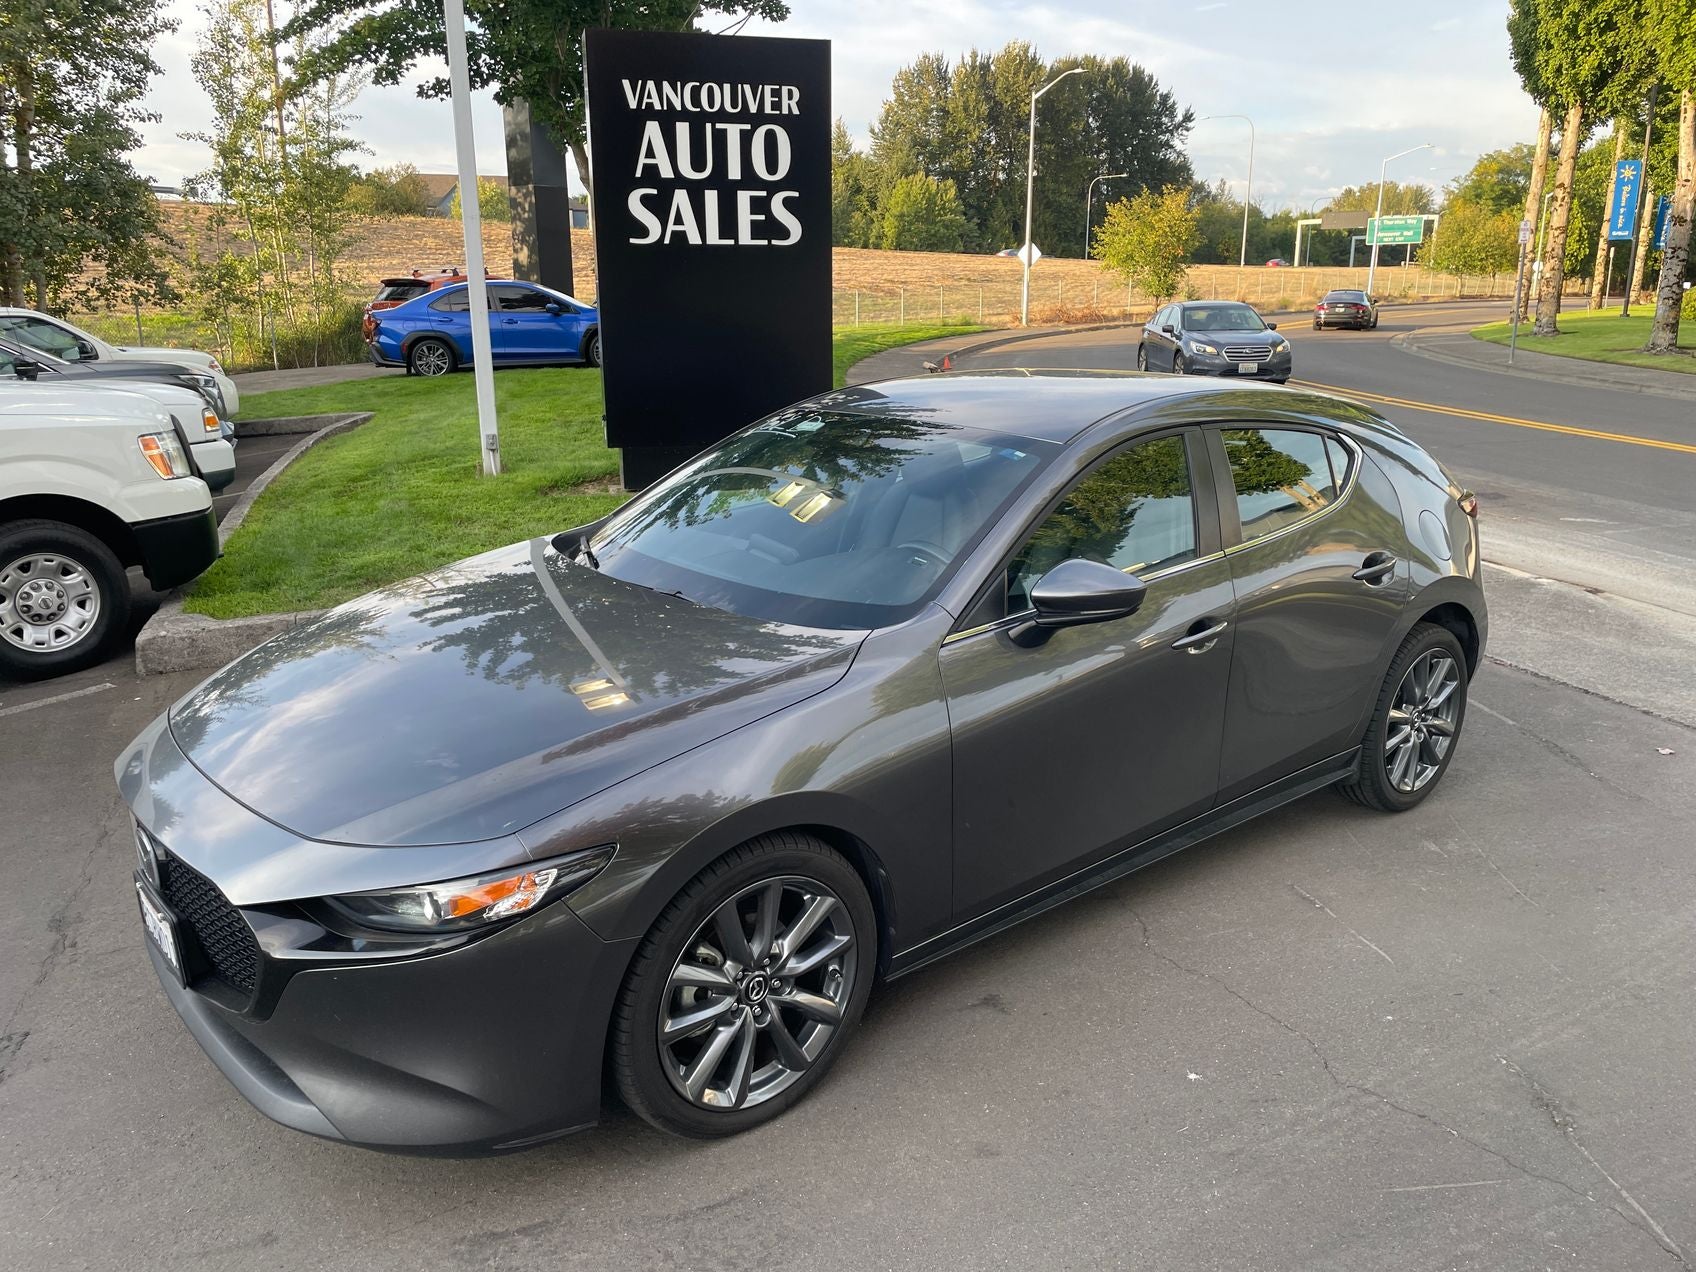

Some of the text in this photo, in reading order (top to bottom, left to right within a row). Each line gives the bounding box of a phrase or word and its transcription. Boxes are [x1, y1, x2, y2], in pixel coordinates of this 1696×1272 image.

[621, 79, 800, 115] VANCOUVER
[635, 121, 792, 181] AUTO
[627, 187, 803, 246] SALES
